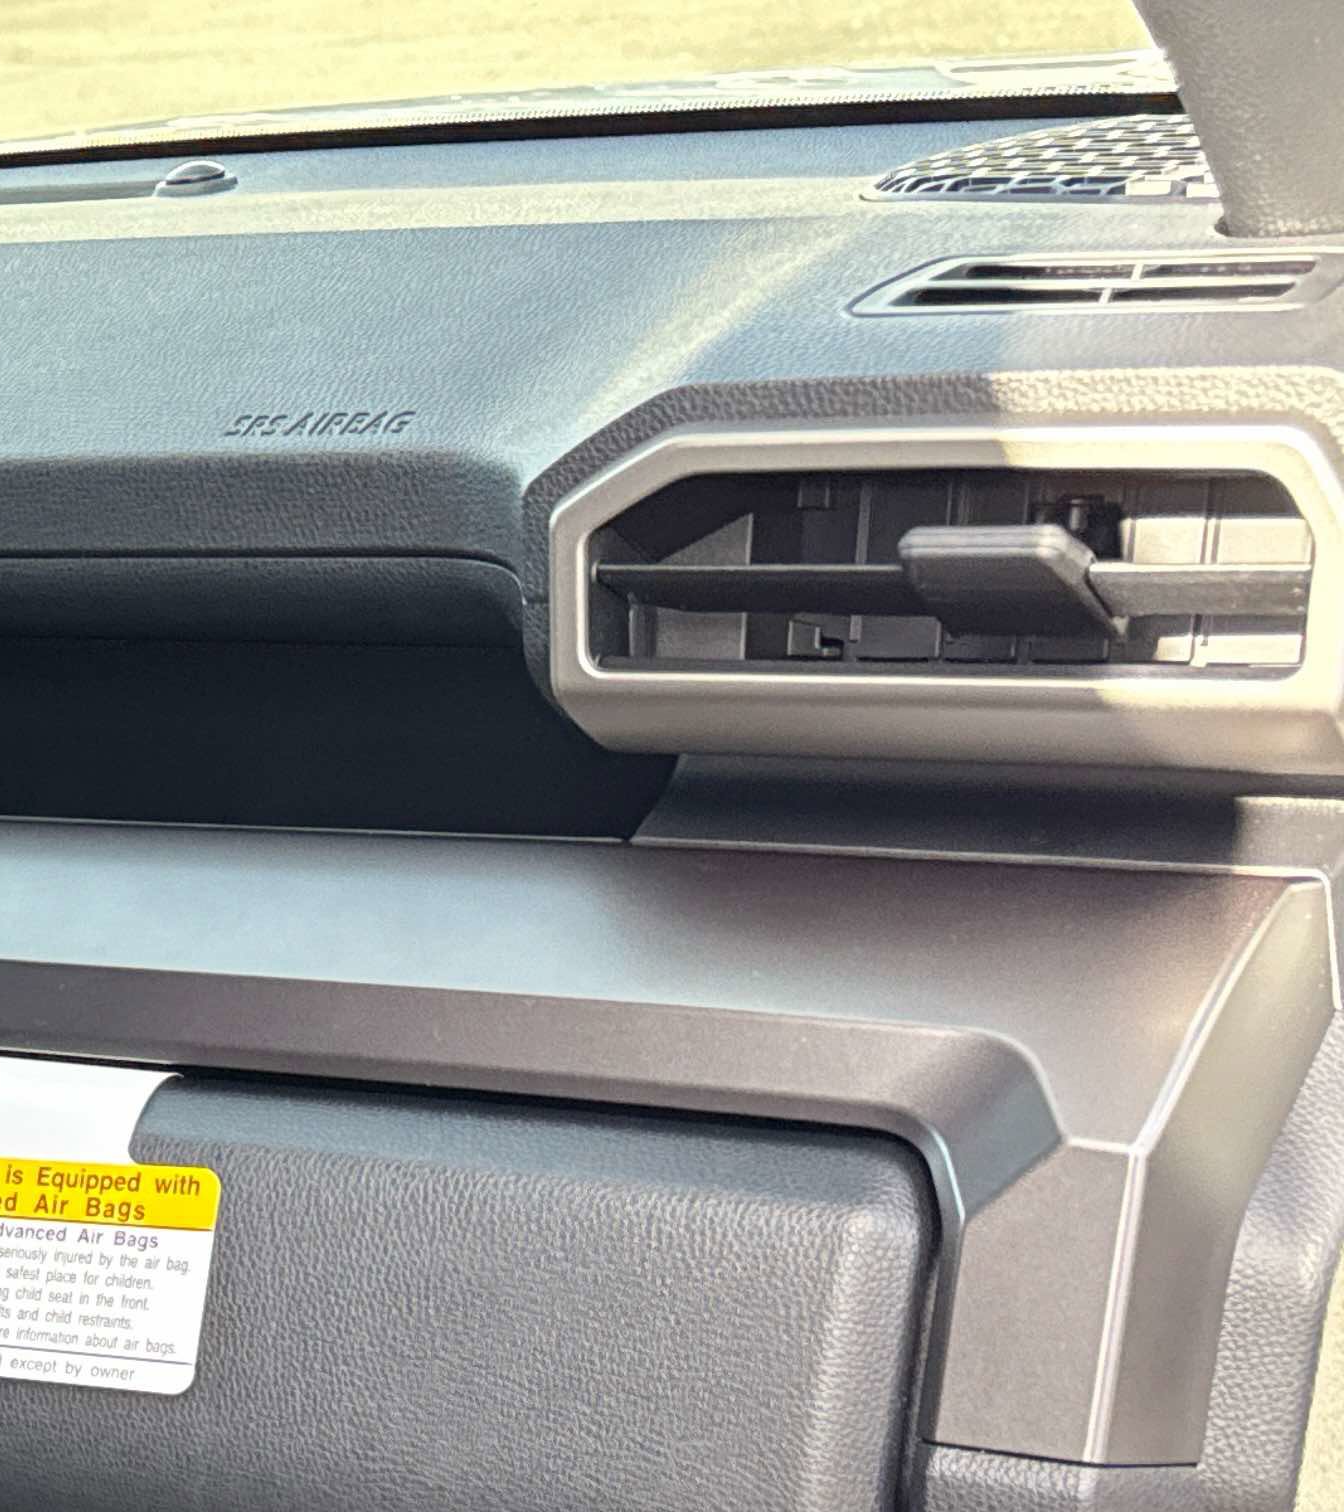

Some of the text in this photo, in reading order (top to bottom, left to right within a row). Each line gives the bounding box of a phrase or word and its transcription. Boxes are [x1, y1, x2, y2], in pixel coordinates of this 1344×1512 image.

[223, 410, 416, 437] SRS AIRBAG
[5, 1163, 22, 1185] is
[37, 1166, 141, 1194] Equipped
[155, 1174, 199, 1196] with
[33, 1193, 68, 1214] Air
[85, 1196, 144, 1221] Bags
[76, 1227, 102, 1244] Air
[113, 1230, 158, 1250] Bags
[54, 1248, 93, 1265] injured
[98, 1251, 111, 1269] by
[119, 1251, 140, 1268] the
[144, 1255, 159, 1269] air
[166, 1255, 190, 1275] bag.
[6, 1265, 40, 1280] safest
[44, 1269, 76, 1284] place
[83, 1270, 97, 1285] for
[105, 1273, 153, 1289] children.
[15, 1286, 42, 1302] child
[48, 1291, 73, 1304] seat
[79, 1291, 88, 1304] in
[95, 1292, 113, 1307] the
[121, 1293, 150, 1311] front.
[17, 1307, 39, 1321] and
[45, 1308, 72, 1324] child
[78, 1314, 132, 1329] restraints.
[16, 1327, 77, 1344] information
[85, 1333, 118, 1349] about
[124, 1336, 138, 1350] air
[146, 1337, 176, 1357] bags.
[10, 1357, 56, 1373] except
[65, 1360, 81, 1377] by
[90, 1365, 134, 1380] owner
